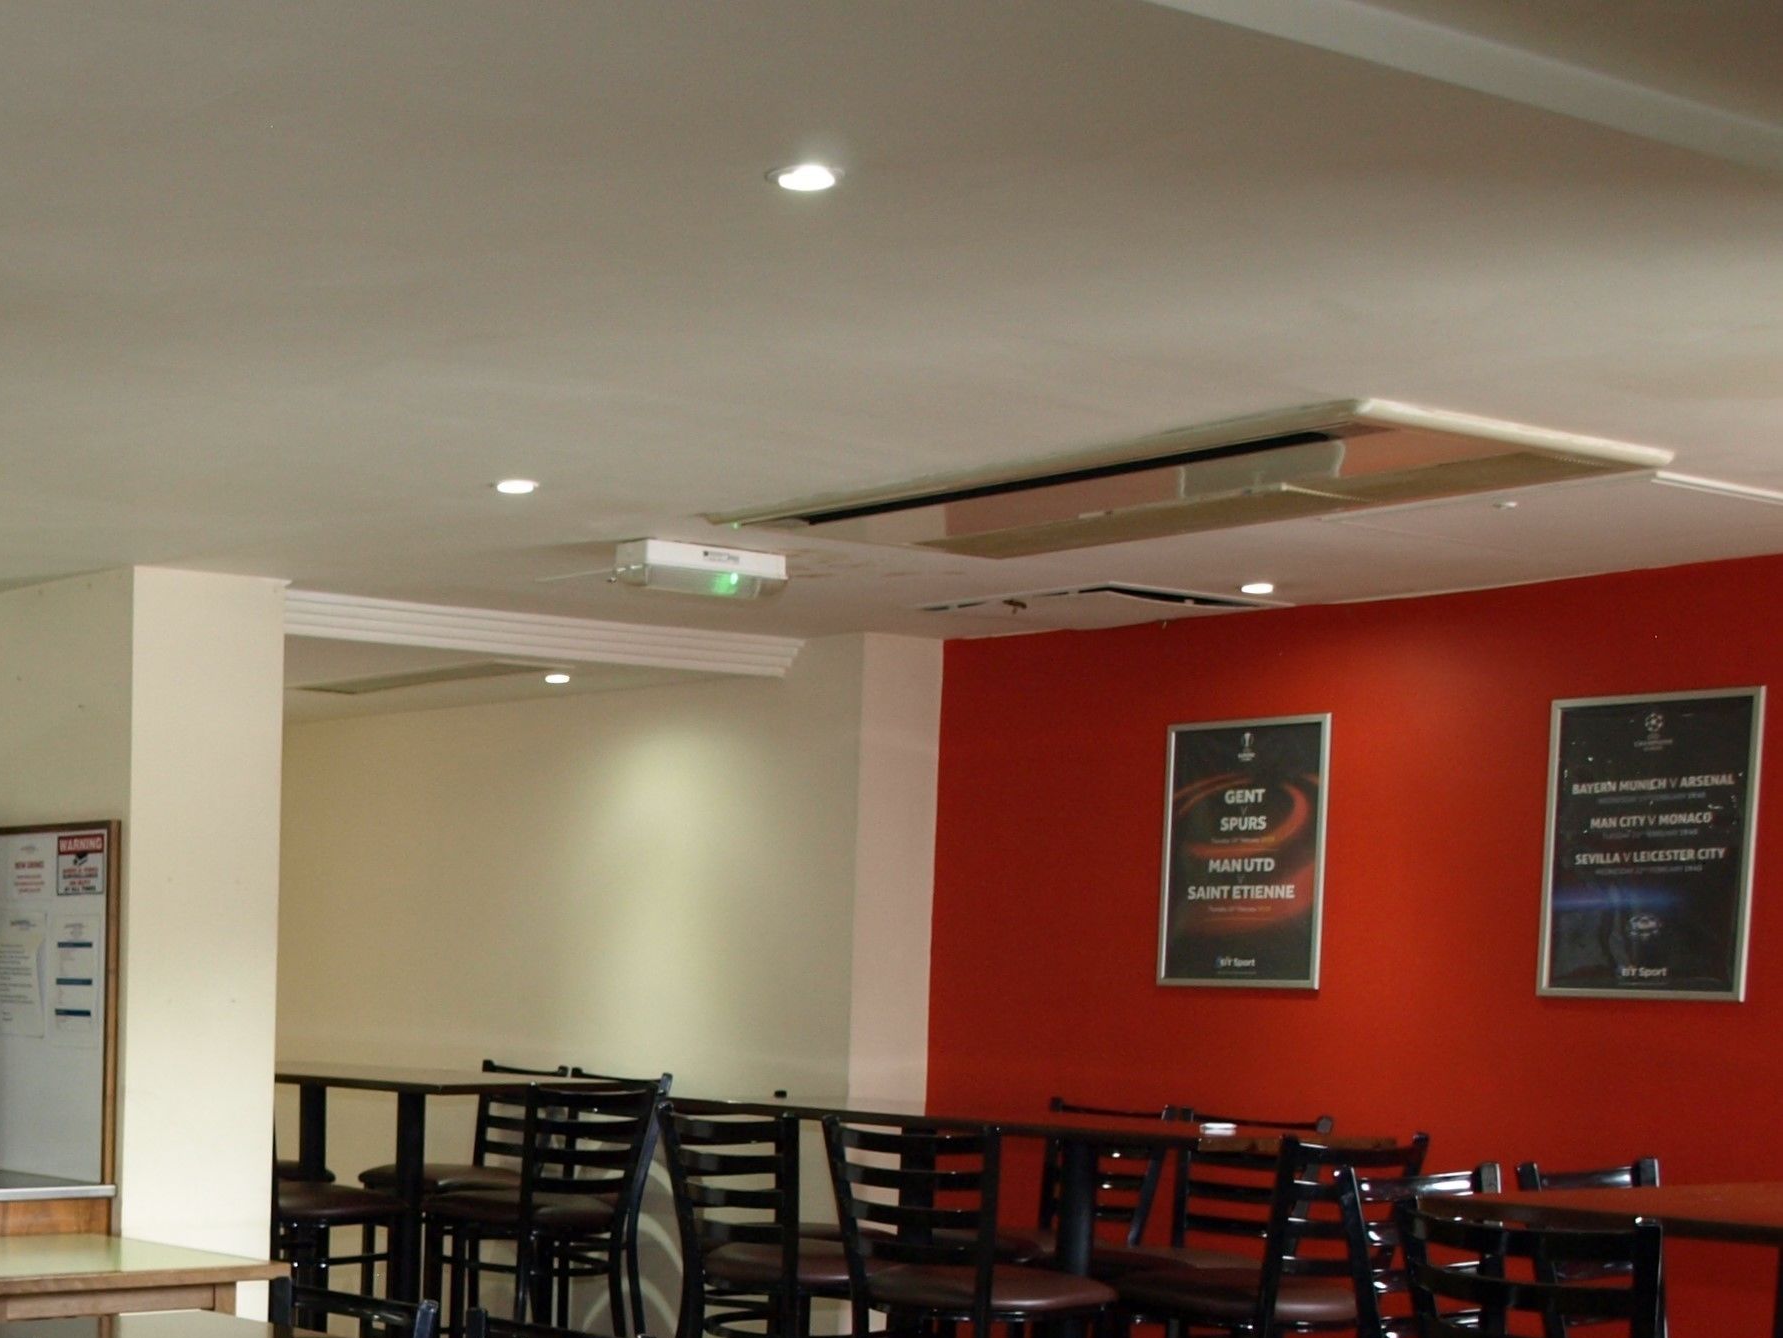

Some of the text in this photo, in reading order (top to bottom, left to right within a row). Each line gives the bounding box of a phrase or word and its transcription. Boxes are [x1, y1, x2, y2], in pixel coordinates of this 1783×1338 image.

[1572, 781, 1617, 795] BAYERN
[1619, 778, 1667, 792] MUNICH
[1679, 774, 1735, 788] ARSENAL
[1224, 788, 1266, 804] GENT
[1220, 816, 1267, 832] SPURS
[1590, 818, 1617, 829] MAN
[1620, 816, 1647, 828] CITY
[1658, 812, 1712, 826] MONACO
[59, 836, 102, 852] WARNING
[1208, 858, 1275, 872] MAN UTD
[1575, 853, 1620, 866] SEVILLA
[1633, 850, 1695, 864] LEICESTER
[1697, 848, 1726, 860] CITY
[1188, 884, 1296, 900] SAINT ETIENNE
[1639, 967, 1667, 978] Sport
